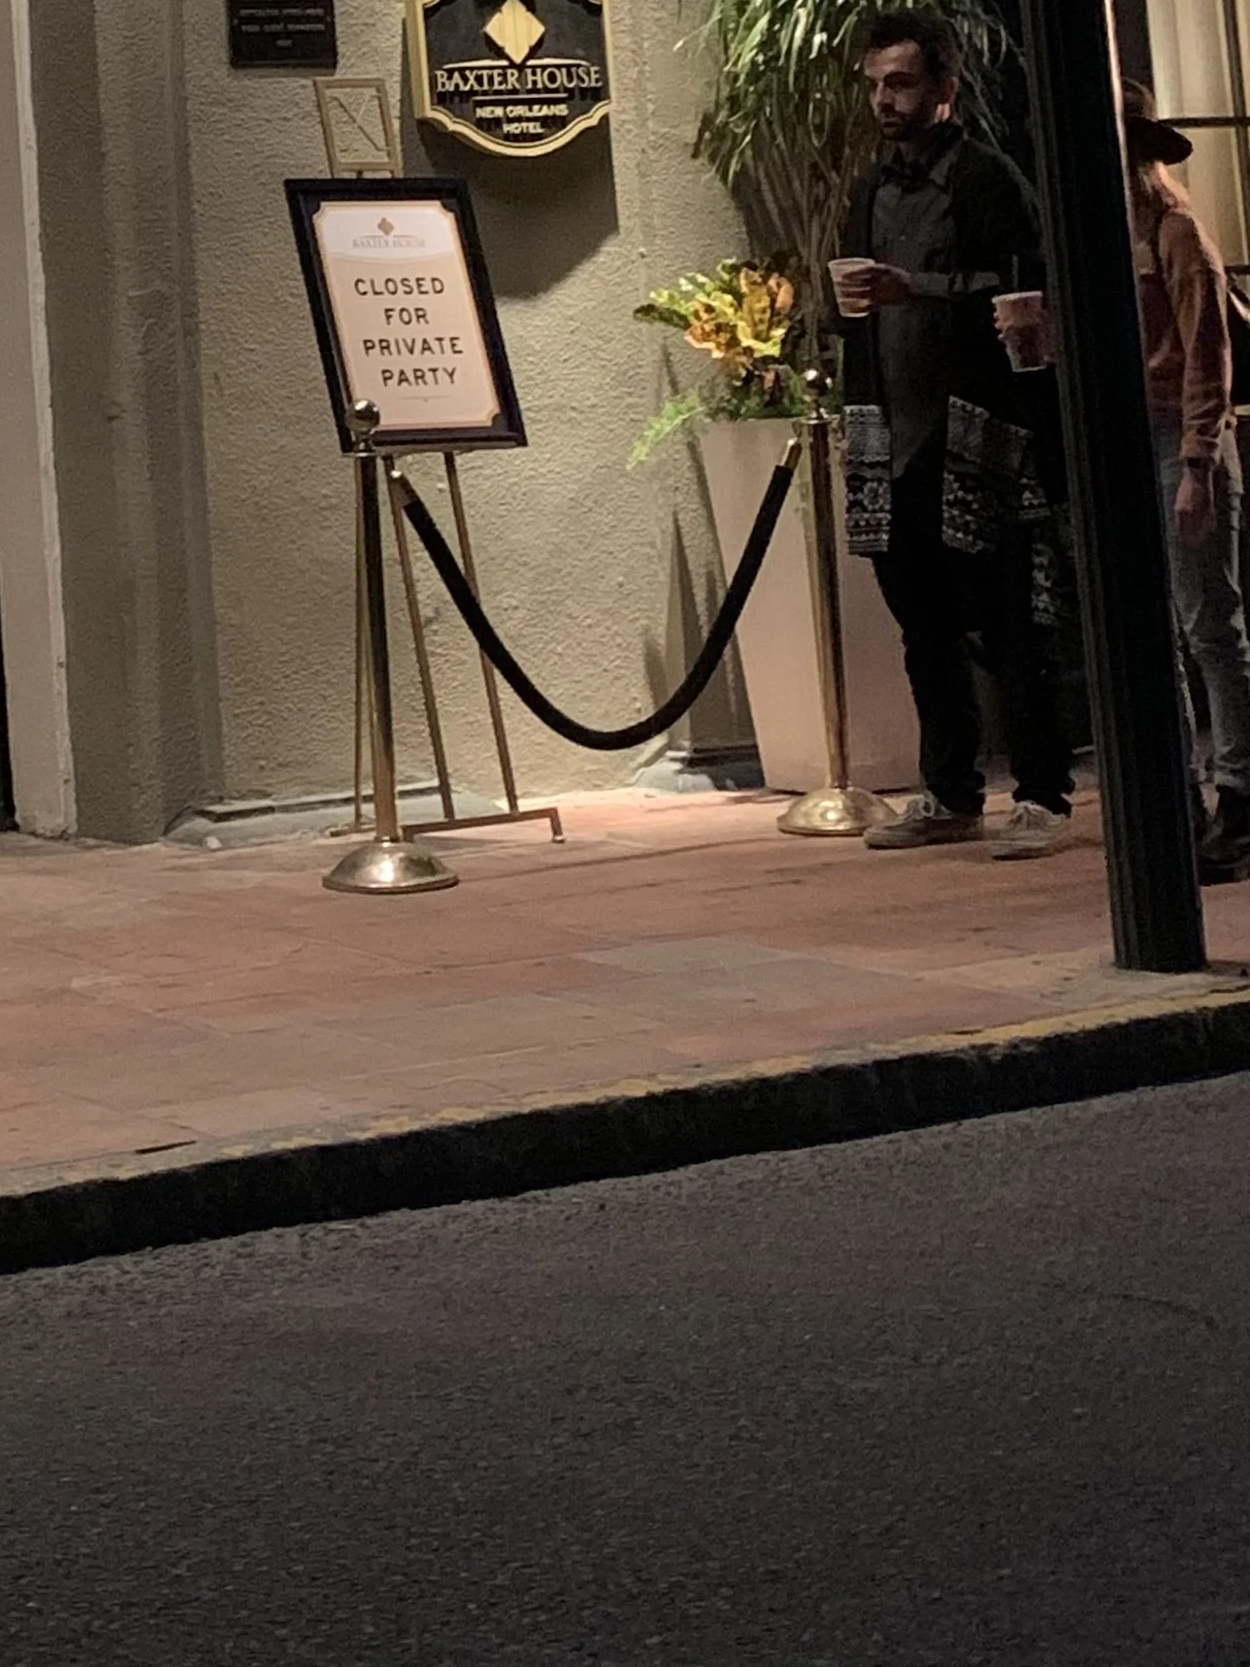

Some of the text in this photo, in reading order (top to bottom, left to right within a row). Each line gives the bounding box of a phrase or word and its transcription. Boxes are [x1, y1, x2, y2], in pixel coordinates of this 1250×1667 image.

[435, 67, 603, 92] BAXTER HOUSE
[475, 104, 569, 118] NEW ORLEANS
[503, 121, 545, 134] HOTEL
[354, 277, 445, 296] CLOSED
[384, 307, 429, 326] FOR
[363, 336, 464, 356] PRIVATE
[381, 367, 457, 387] PARTY
